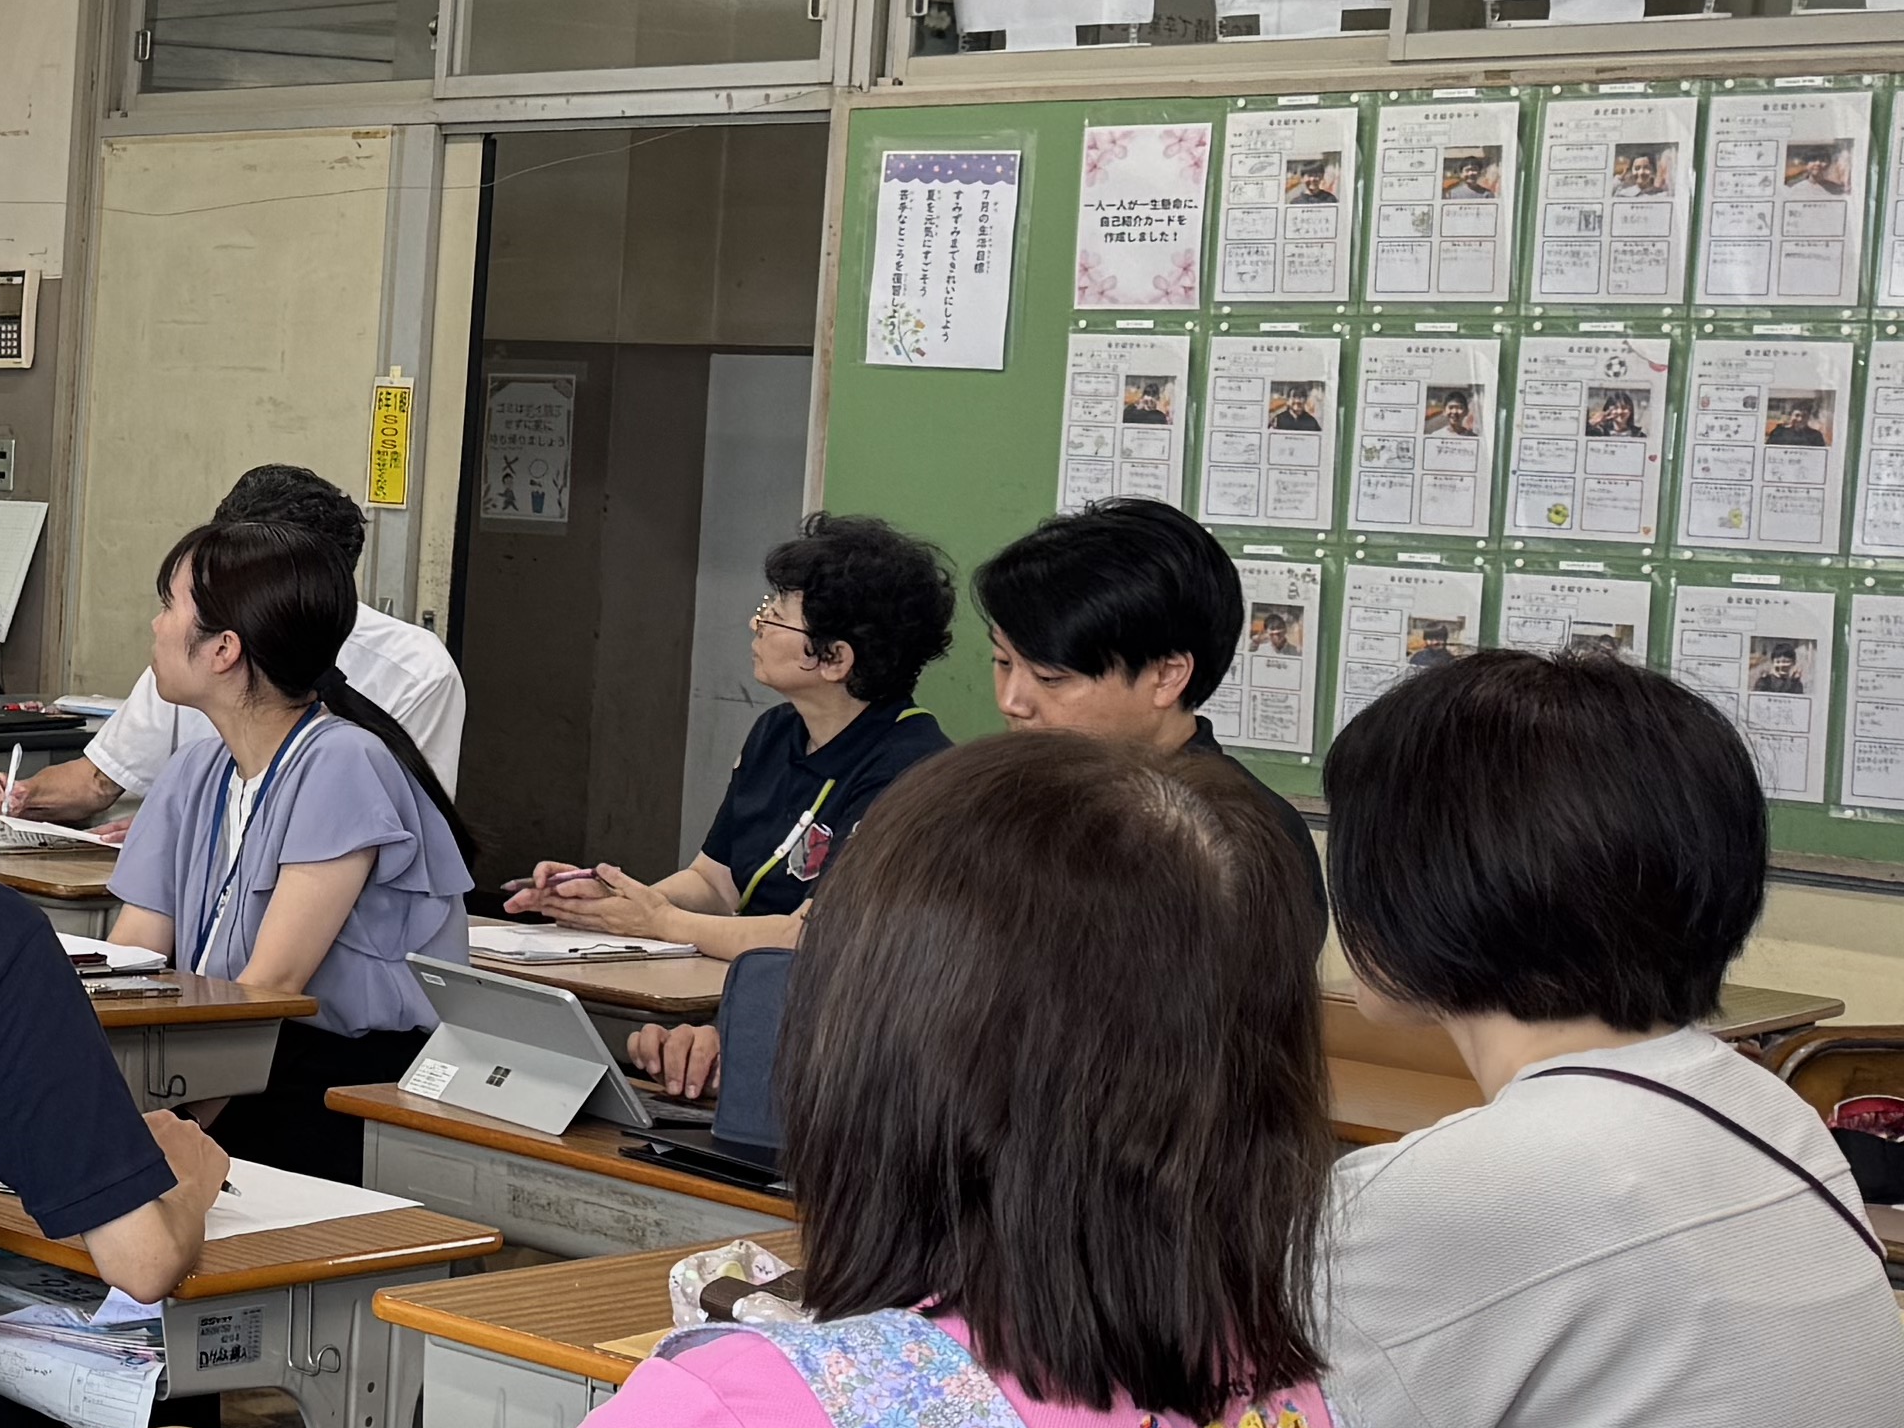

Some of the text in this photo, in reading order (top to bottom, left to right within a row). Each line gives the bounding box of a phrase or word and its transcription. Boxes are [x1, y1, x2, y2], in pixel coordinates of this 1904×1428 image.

[1084, 198, 1198, 211] 一人一人が一生懸命に、
[1100, 215, 1187, 227] 自己紹介カードを
[381, 414, 398, 450] SOS
